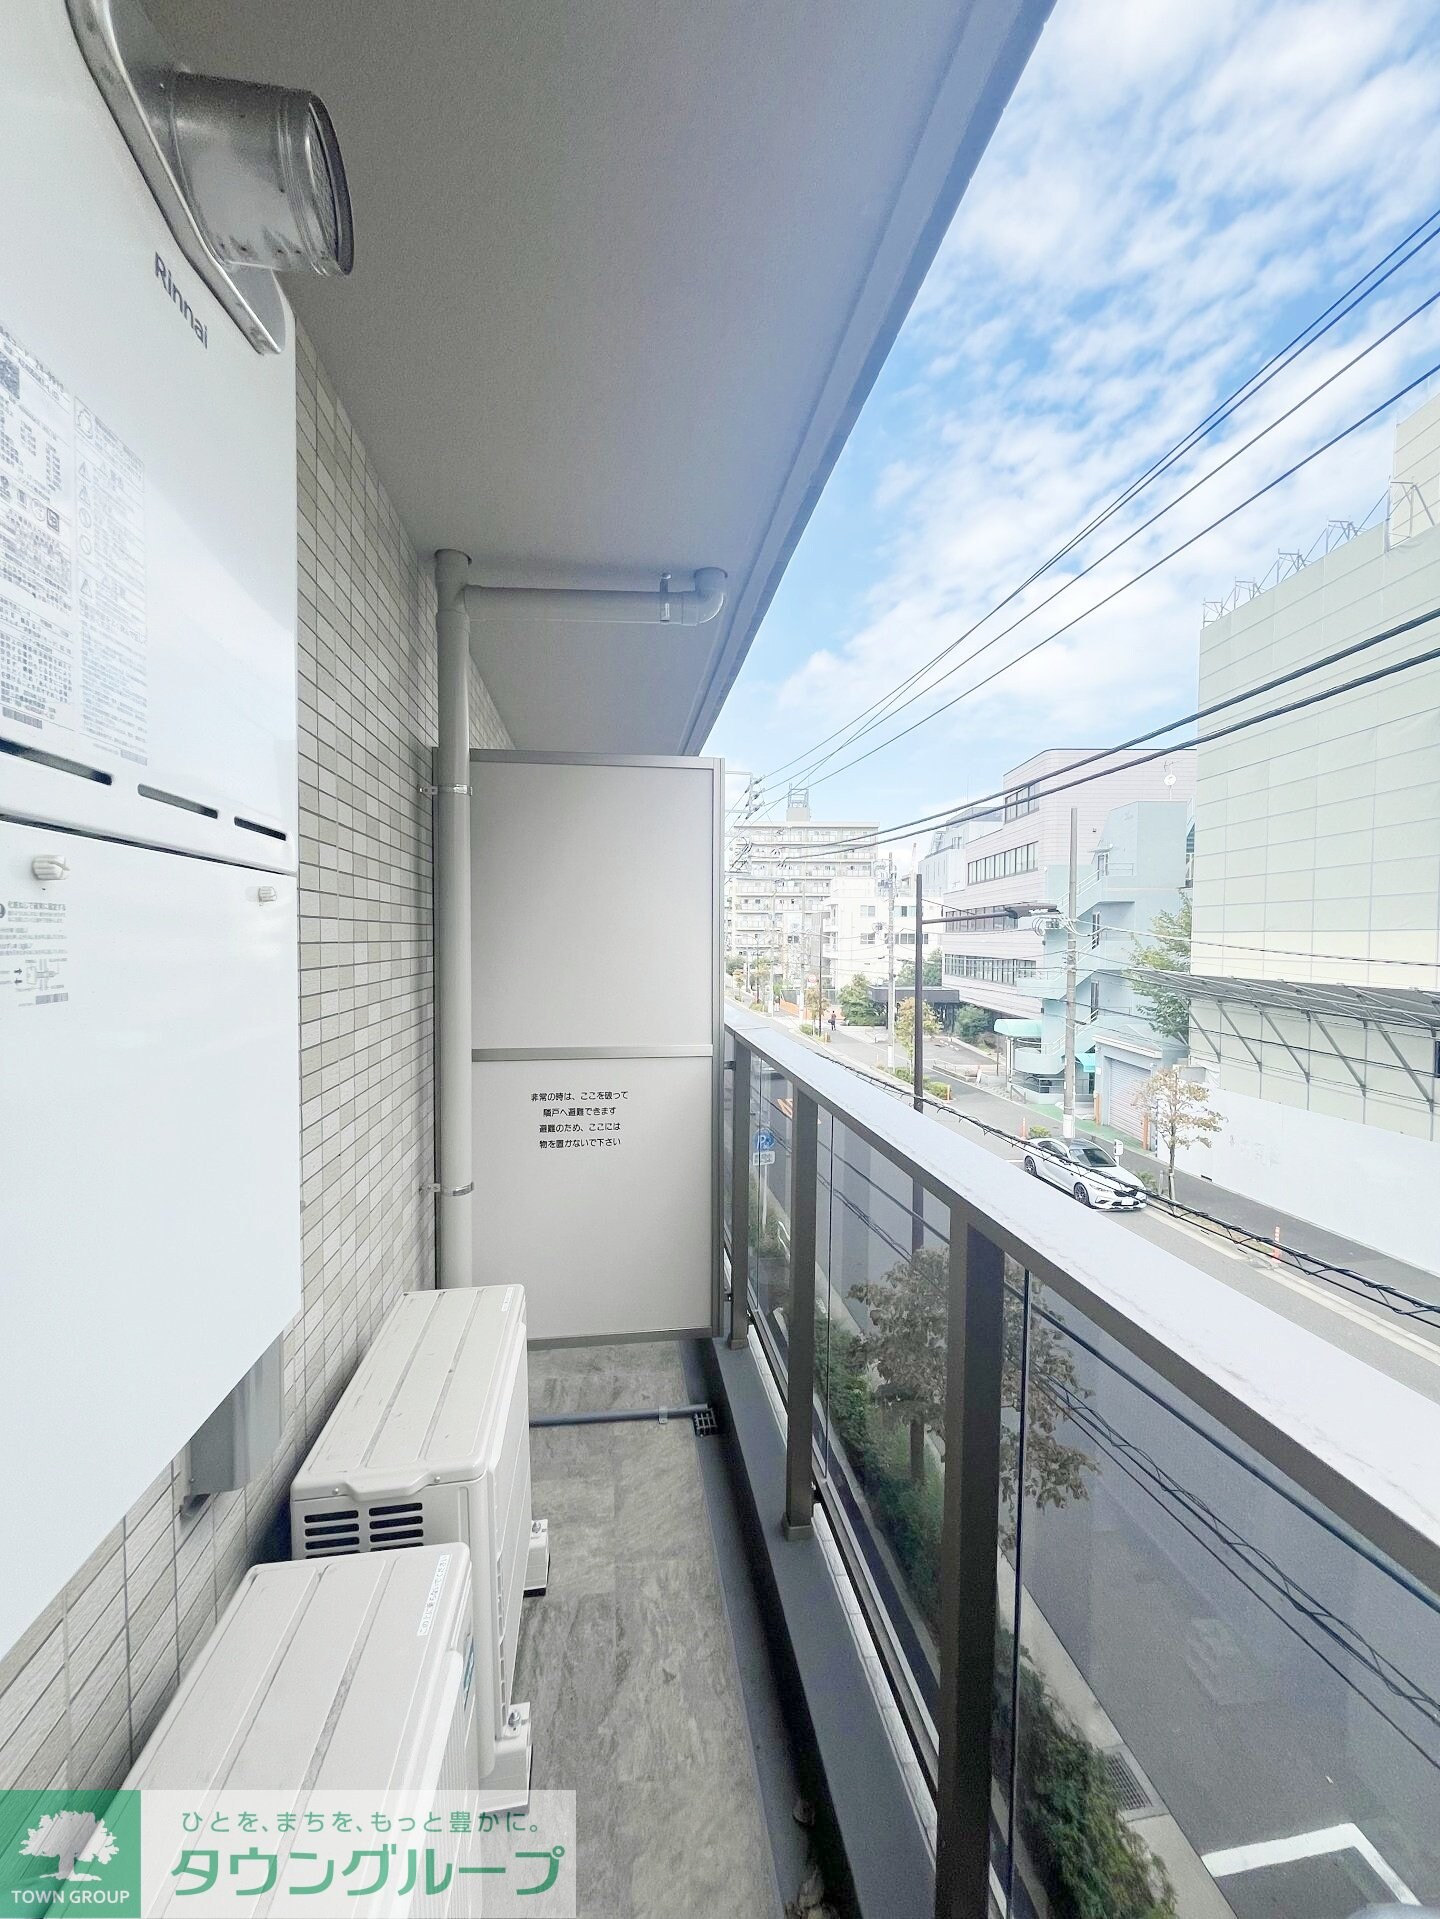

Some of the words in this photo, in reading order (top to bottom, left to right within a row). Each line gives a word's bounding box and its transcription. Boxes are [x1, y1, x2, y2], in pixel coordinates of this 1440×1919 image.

[154, 251, 208, 349] Rinnai
[543, 1107, 617, 1117] 隣戸へ避難できます
[539, 1122, 621, 1133] 避難のため、ここには
[539, 1138, 621, 1149] 物を置かないで下さい
